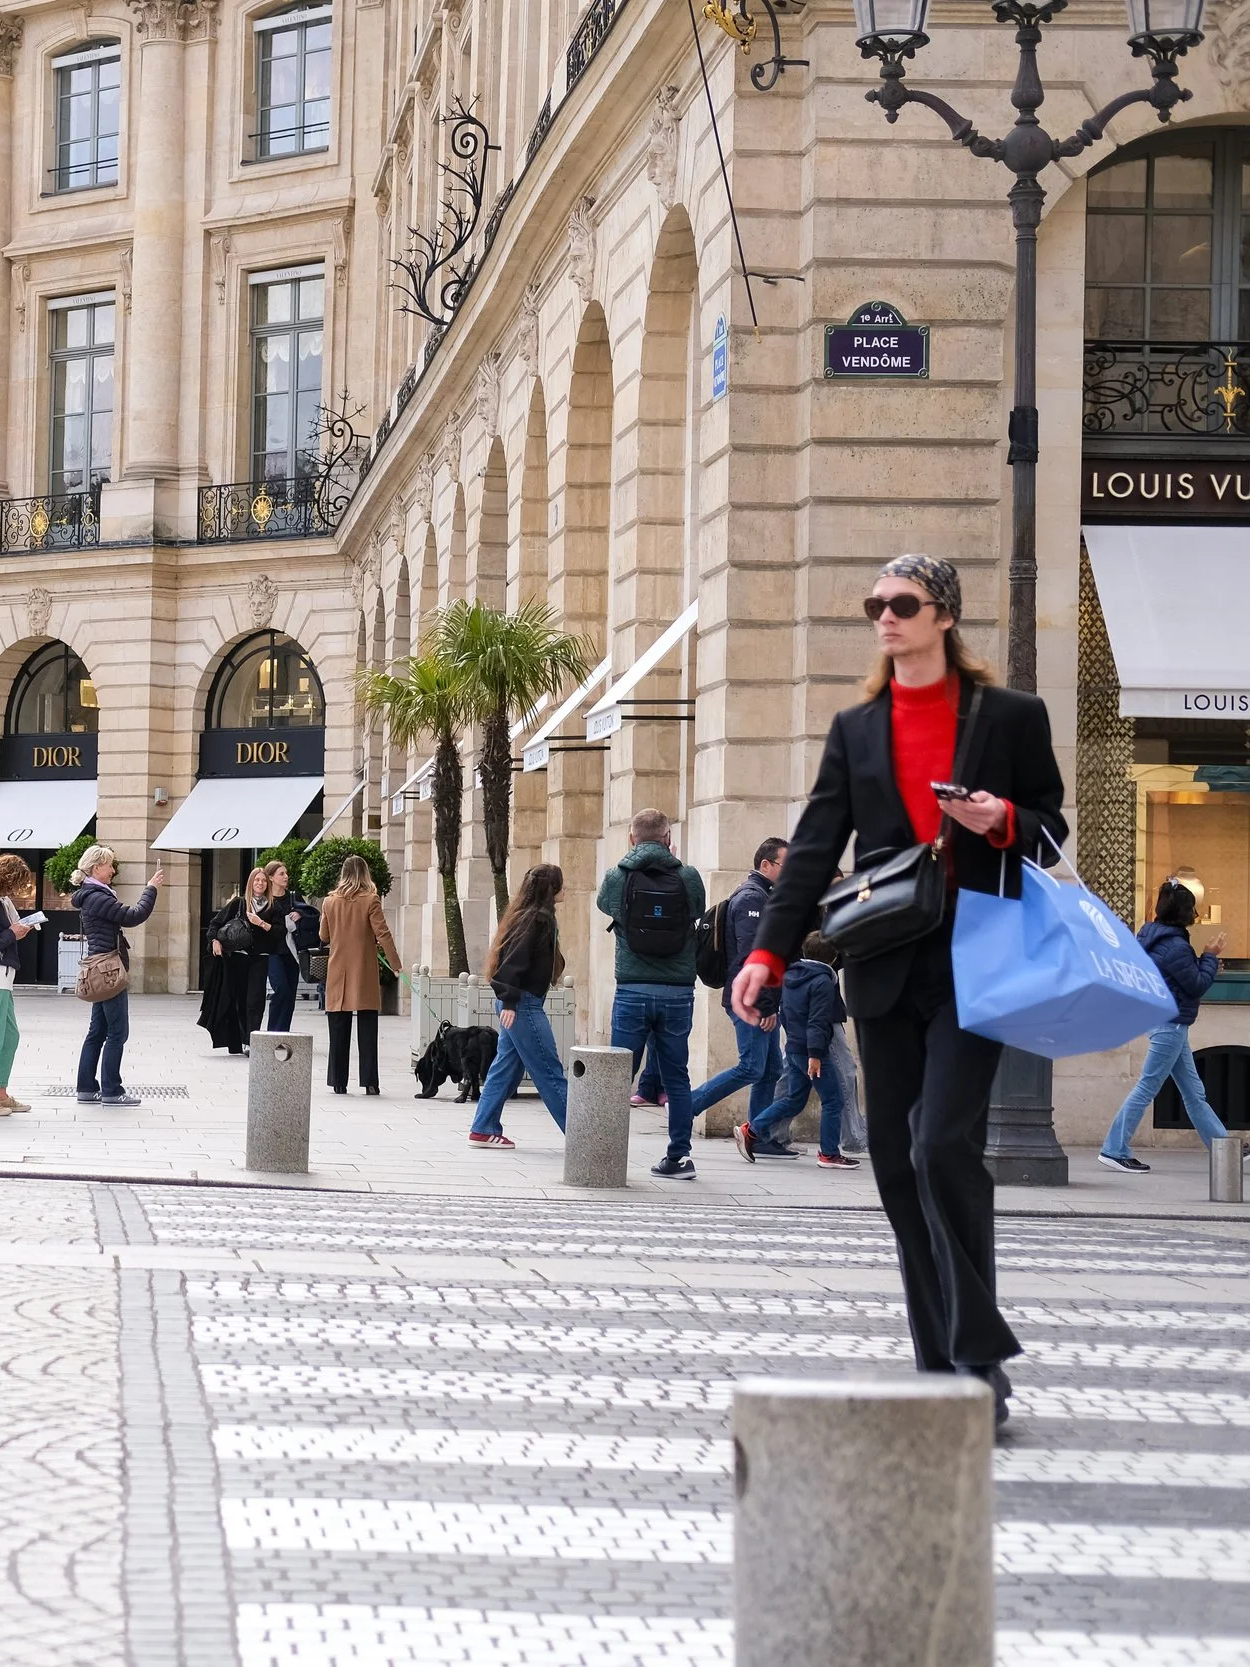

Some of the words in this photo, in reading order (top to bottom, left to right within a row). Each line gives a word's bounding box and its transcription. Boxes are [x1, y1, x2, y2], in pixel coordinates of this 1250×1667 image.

[854, 336, 899, 348] PLACE
[842, 353, 911, 368] VENDÔME
[1092, 472, 1195, 499] LOUIS
[1184, 694, 1249, 711] LOUIS
[33, 746, 82, 767] DIOR
[236, 741, 290, 764] DIOR
